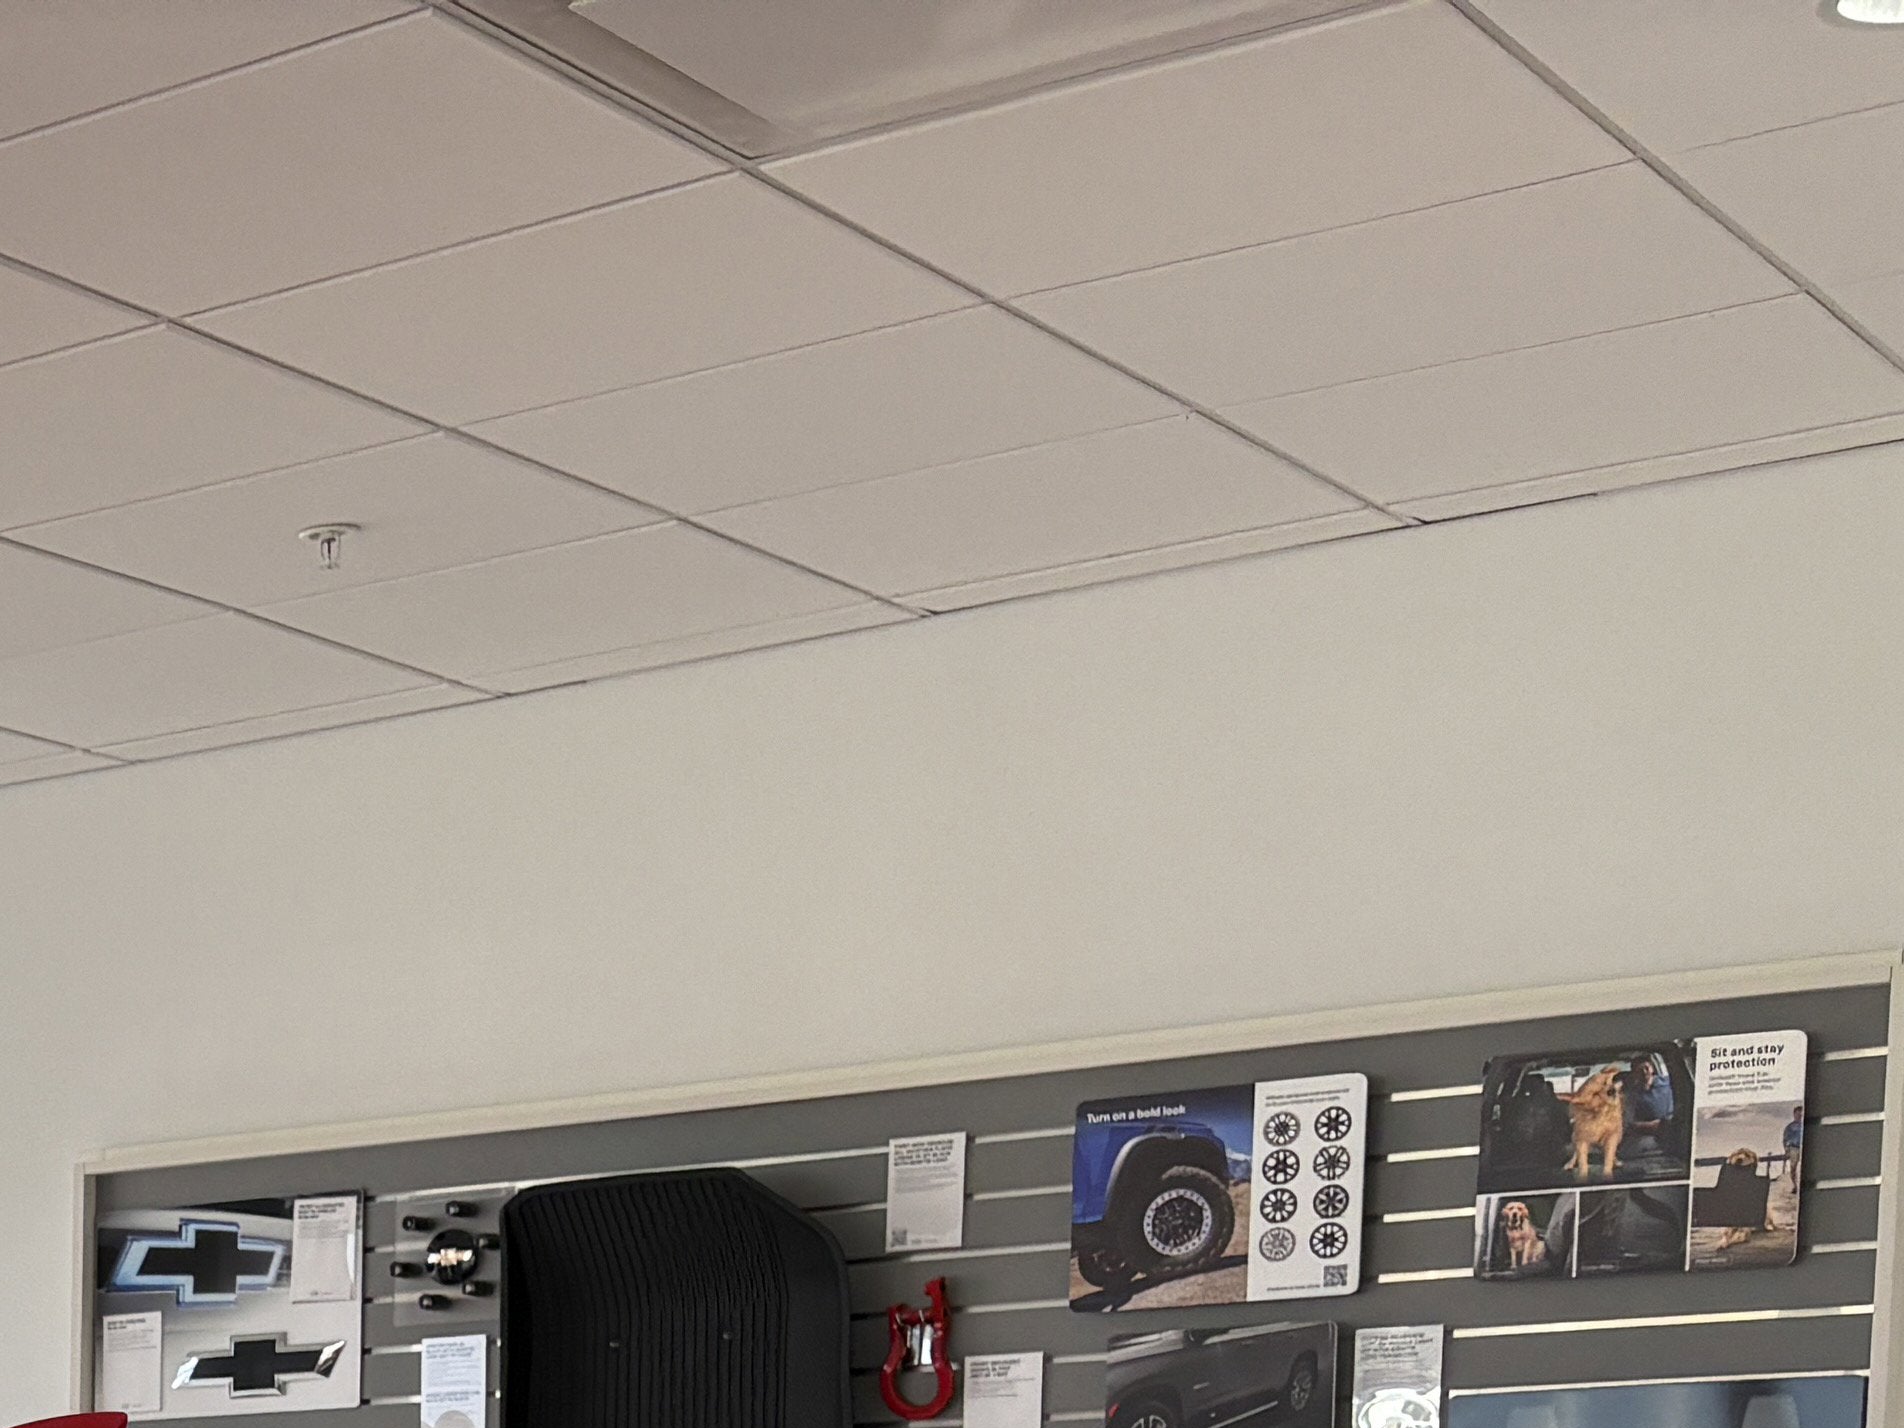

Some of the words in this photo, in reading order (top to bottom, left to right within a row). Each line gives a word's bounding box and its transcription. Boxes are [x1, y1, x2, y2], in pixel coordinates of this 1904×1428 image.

[1710, 1047, 1728, 1059] Sit
[1730, 1046, 1754, 1057] and
[1756, 1044, 1784, 1056] stay
[1709, 1057, 1776, 1072] protection
[1086, 1113, 1111, 1124] Turn
[1112, 1111, 1126, 1122] on
[1136, 1107, 1161, 1119] bold
[1162, 1104, 1186, 1117] look
